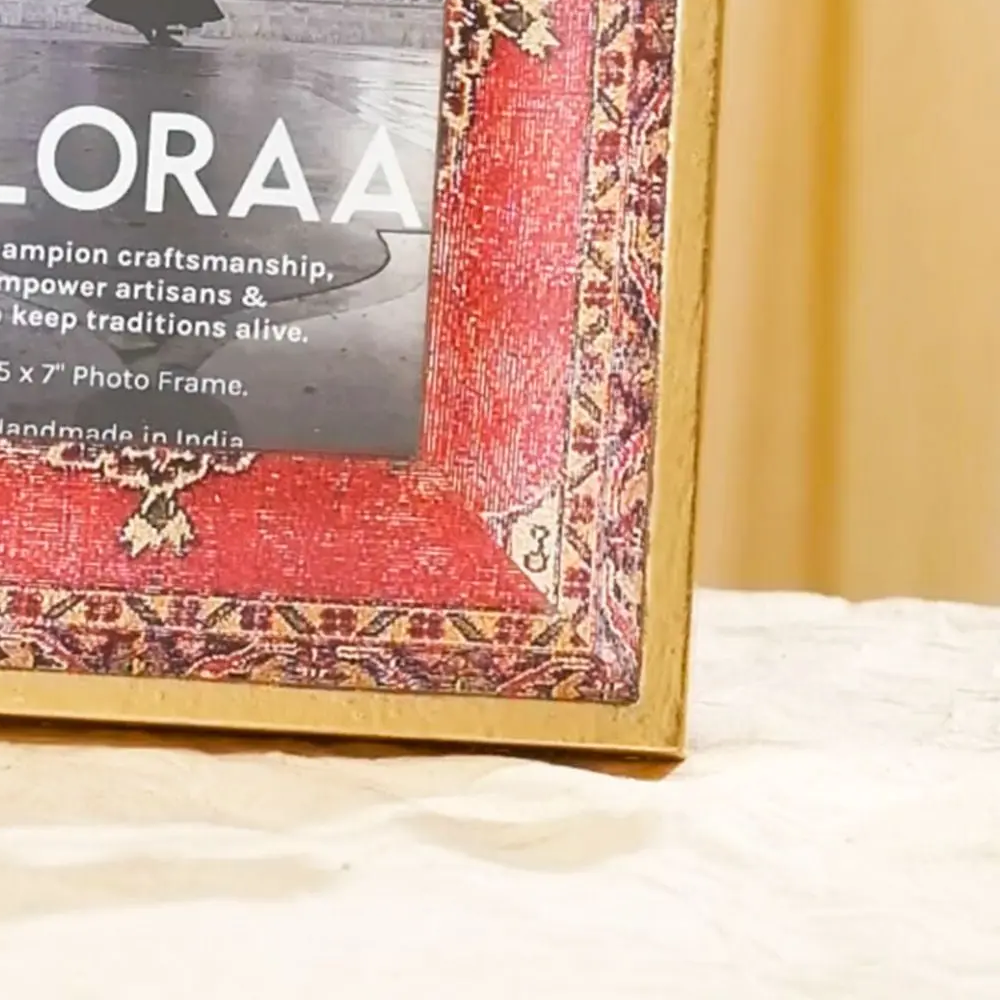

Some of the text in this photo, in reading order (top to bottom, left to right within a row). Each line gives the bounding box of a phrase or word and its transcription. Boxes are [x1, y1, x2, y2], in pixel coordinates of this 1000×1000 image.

[118, 247, 334, 284] craftsmanship,
[115, 279, 232, 305] artisans
[242, 285, 267, 308] &
[12, 304, 77, 334] keep
[87, 310, 226, 338] traditions
[235, 317, 309, 343] alive.
[18, 366, 34, 384] x
[41, 363, 65, 385] 7"
[73, 365, 150, 391] Photo
[158, 371, 249, 397] Frame.
[143, 425, 167, 444] in
[176, 429, 244, 448] India
